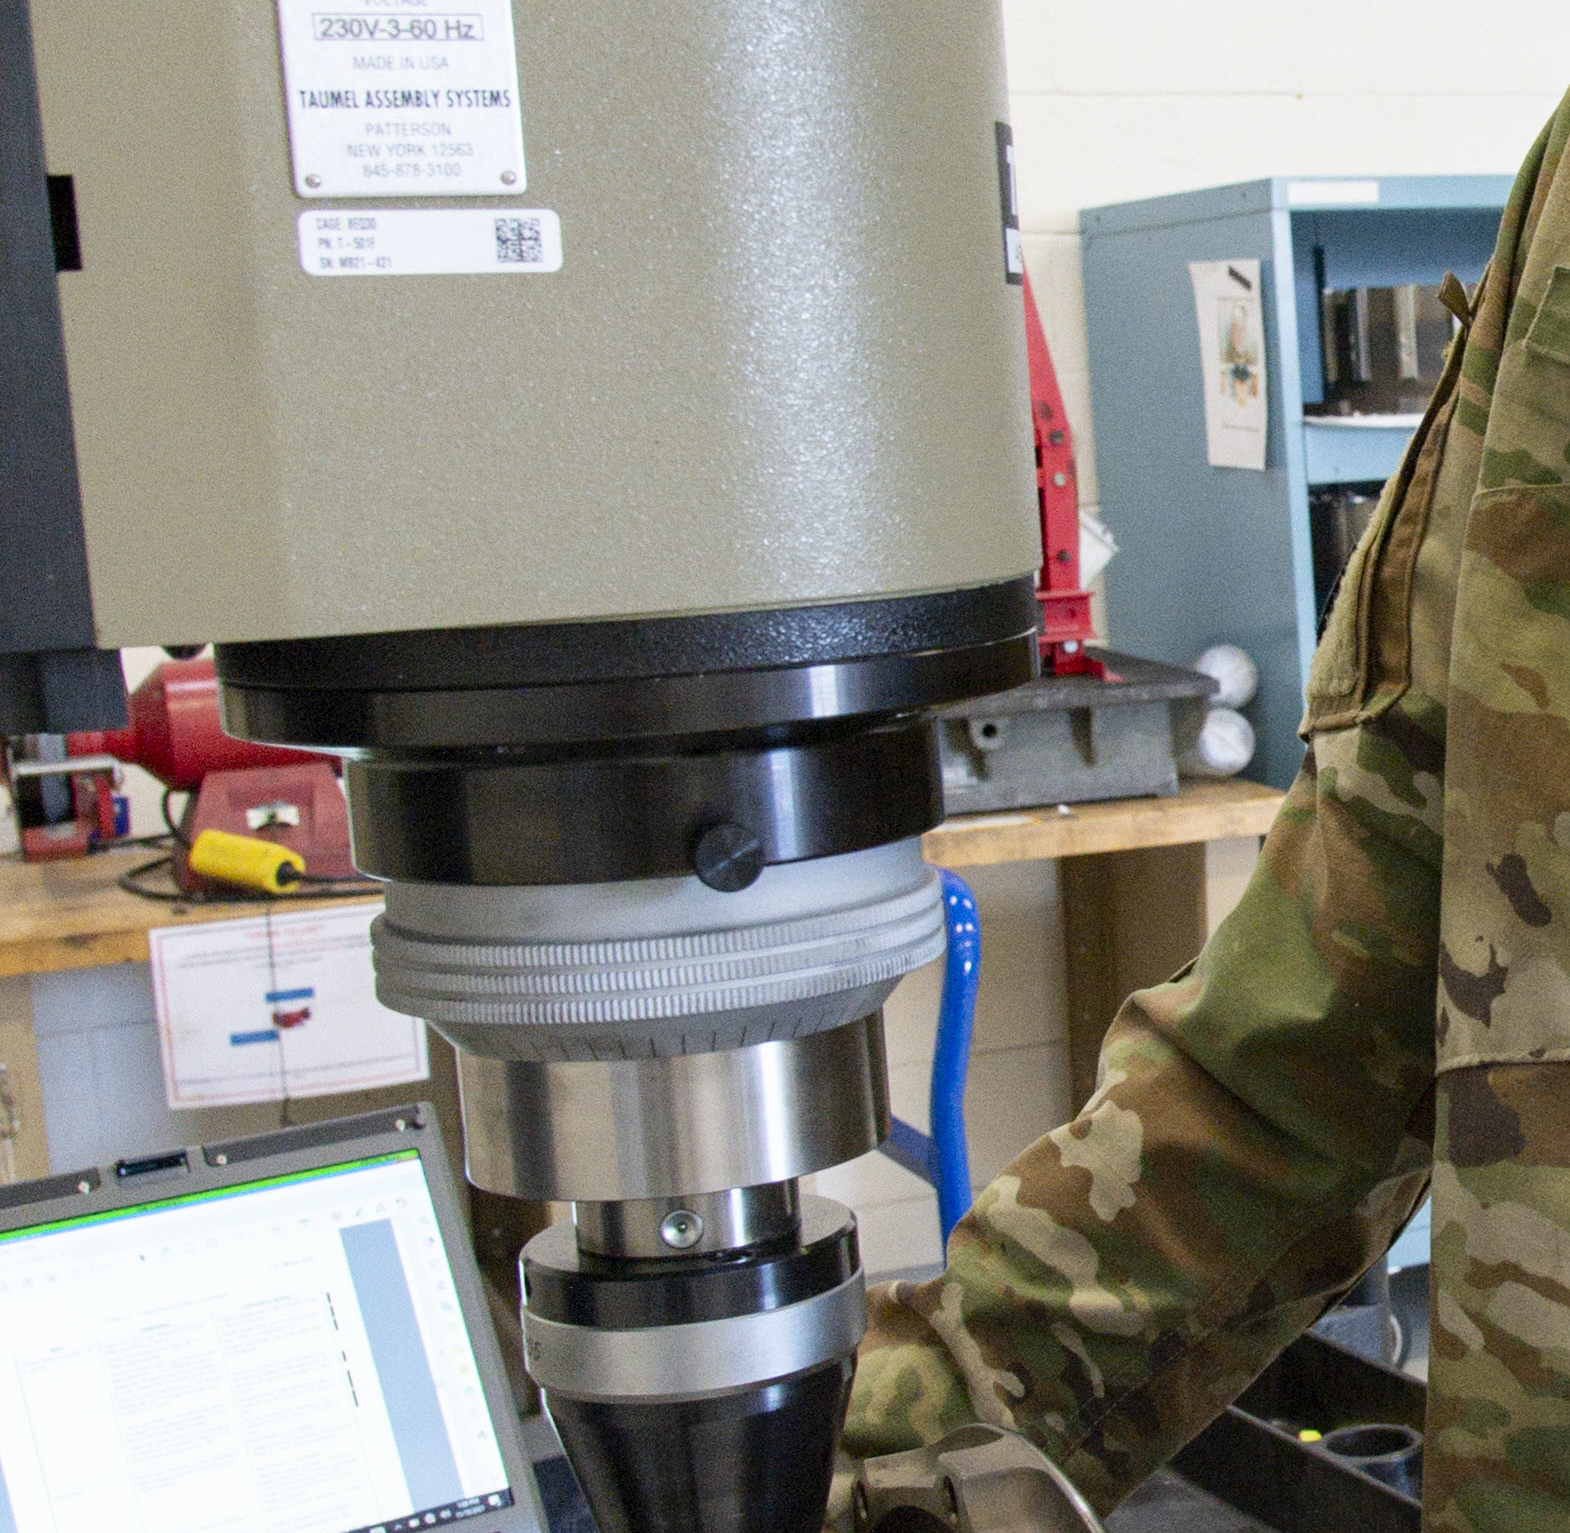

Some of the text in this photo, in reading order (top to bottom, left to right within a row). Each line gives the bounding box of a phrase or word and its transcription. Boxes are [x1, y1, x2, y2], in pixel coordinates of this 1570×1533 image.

[320, 18, 475, 39] 230V-3-60 Hz
[353, 55, 449, 69] MADE IN USA
[299, 88, 512, 108] TAUMEL ASSEMBLY SYSTEMS
[364, 122, 452, 136] PATTERSON
[347, 143, 382, 157] NEW
[388, 144, 425, 157] YORK
